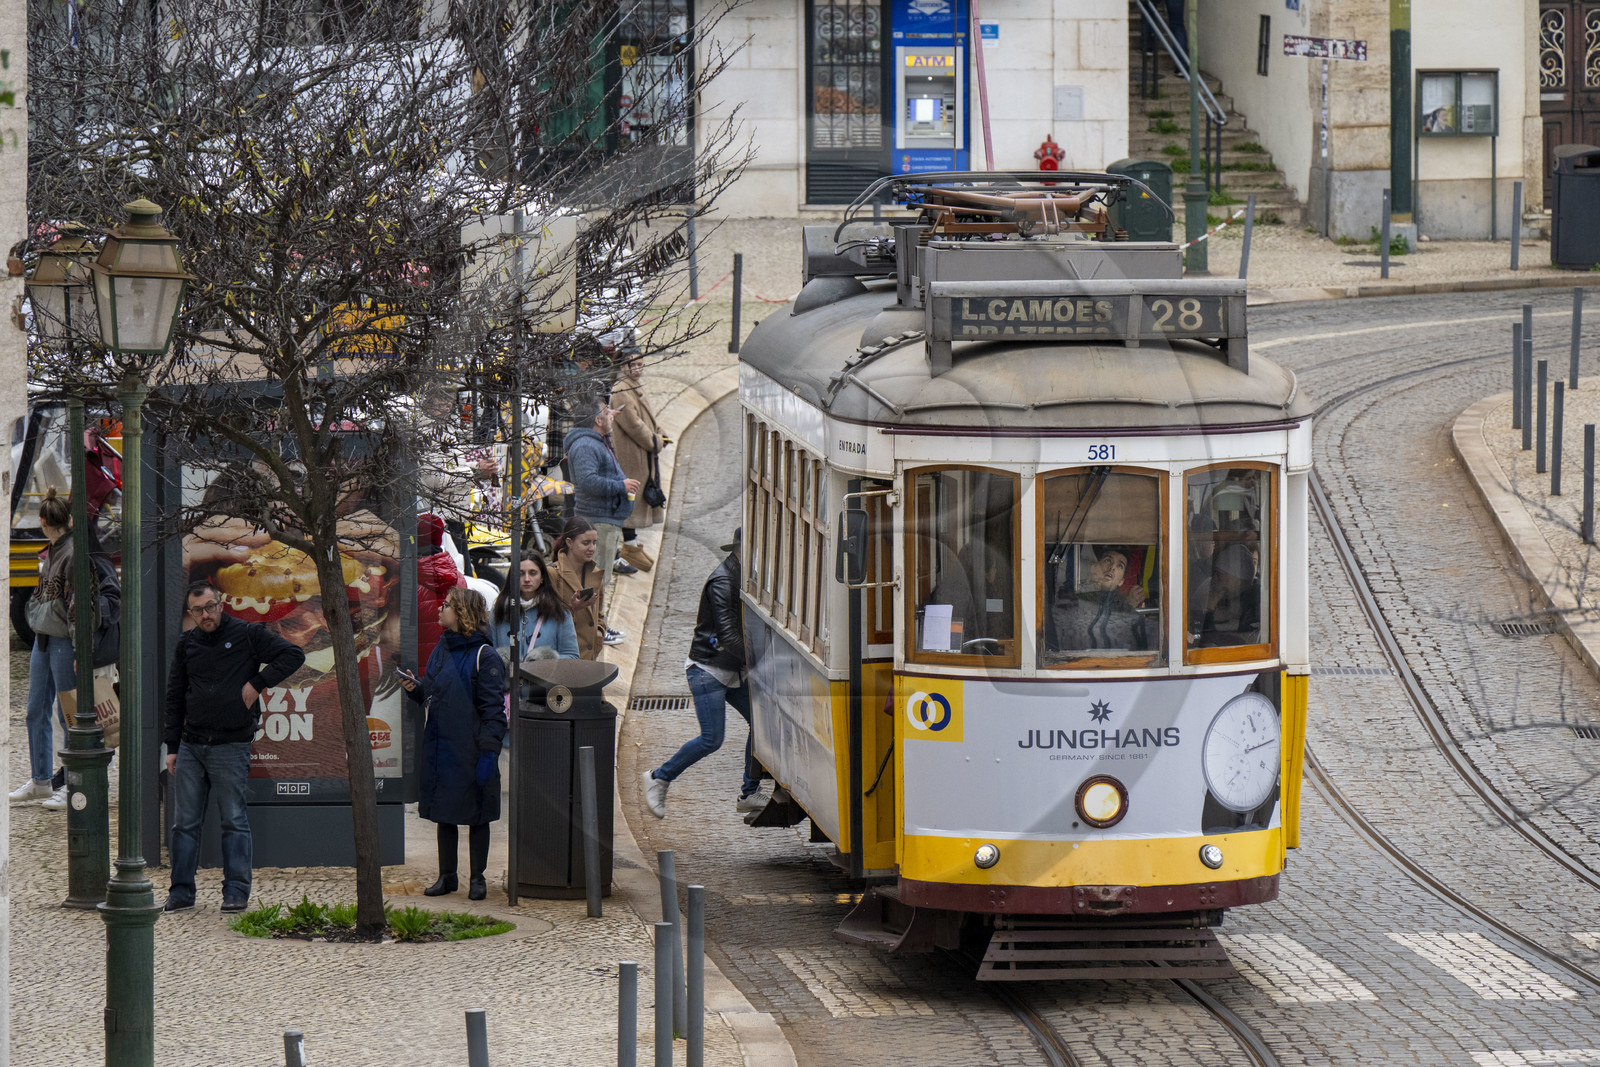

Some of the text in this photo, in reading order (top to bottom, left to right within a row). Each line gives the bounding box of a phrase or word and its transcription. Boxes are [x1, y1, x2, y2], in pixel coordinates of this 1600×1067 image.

[914, 56, 946, 67] ATM
[961, 297, 1204, 332] L.CAMÕES 28
[838, 439, 866, 455] ENTRADA
[1087, 444, 1116, 461] 581
[1018, 727, 1180, 749] JUNGHANS
[258, 752, 280, 760] lados.
[1098, 753, 1126, 761] SINCE
[278, 784, 309, 794] MOP
